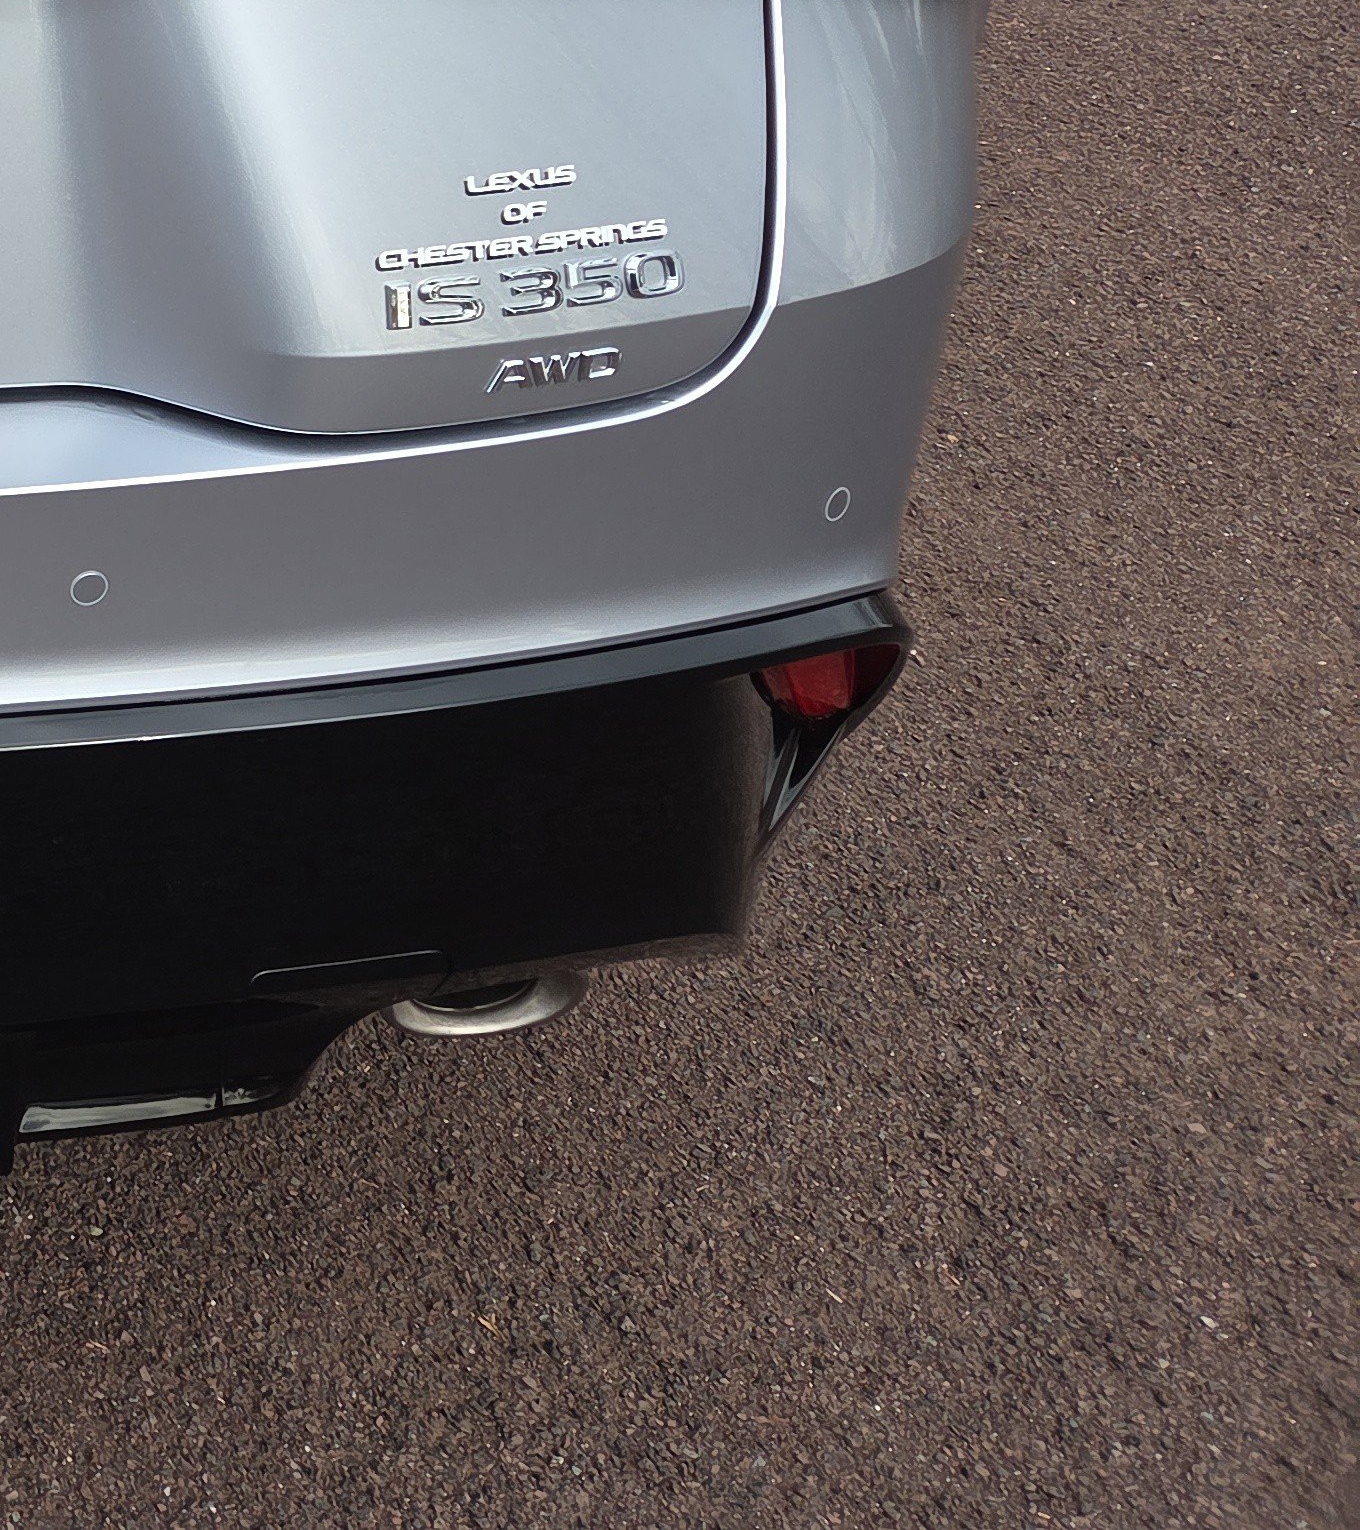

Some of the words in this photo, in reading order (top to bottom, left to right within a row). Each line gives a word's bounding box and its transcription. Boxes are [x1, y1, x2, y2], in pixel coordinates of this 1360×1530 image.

[464, 164, 577, 196] LEXUS
[501, 200, 548, 226] OF
[375, 236, 534, 272] CHESTER
[532, 218, 669, 255] SPRINGS
[384, 276, 485, 331] IS
[499, 249, 686, 318] 350
[483, 346, 623, 393] AWD
